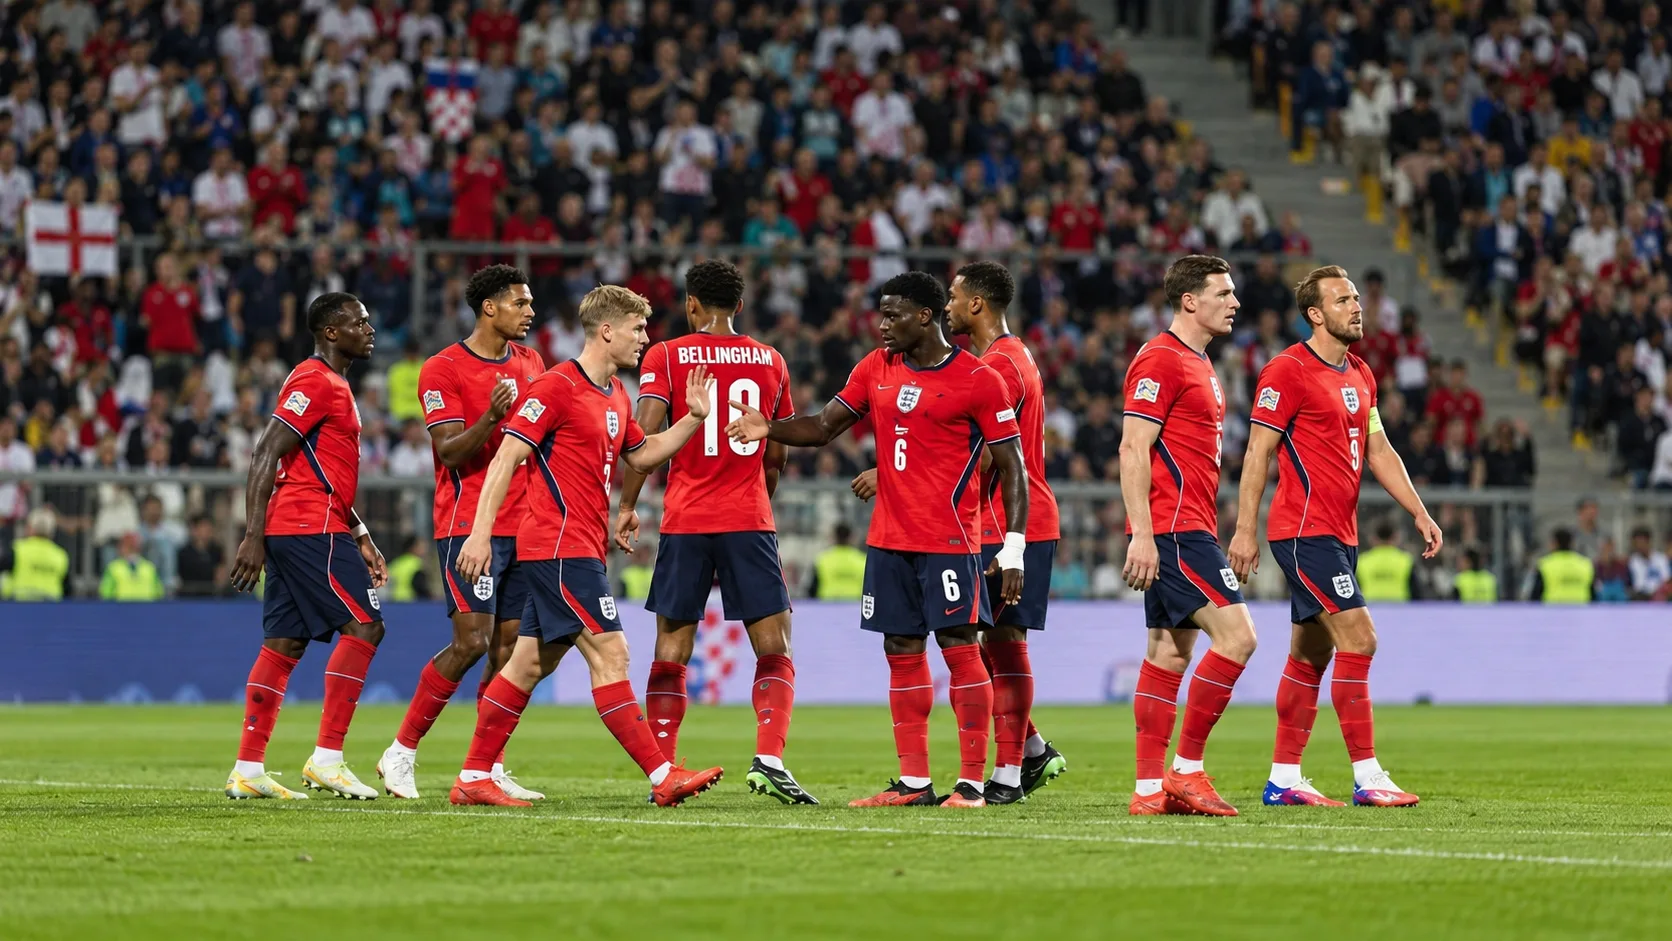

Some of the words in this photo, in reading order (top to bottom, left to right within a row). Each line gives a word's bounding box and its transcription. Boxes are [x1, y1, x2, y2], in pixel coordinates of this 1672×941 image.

[678, 347, 773, 366] BELLINGHAM
[704, 378, 760, 456] 10
[894, 438, 907, 471] 6
[1350, 439, 1359, 471] 9
[603, 463, 611, 497] 2
[941, 569, 960, 602] 6
